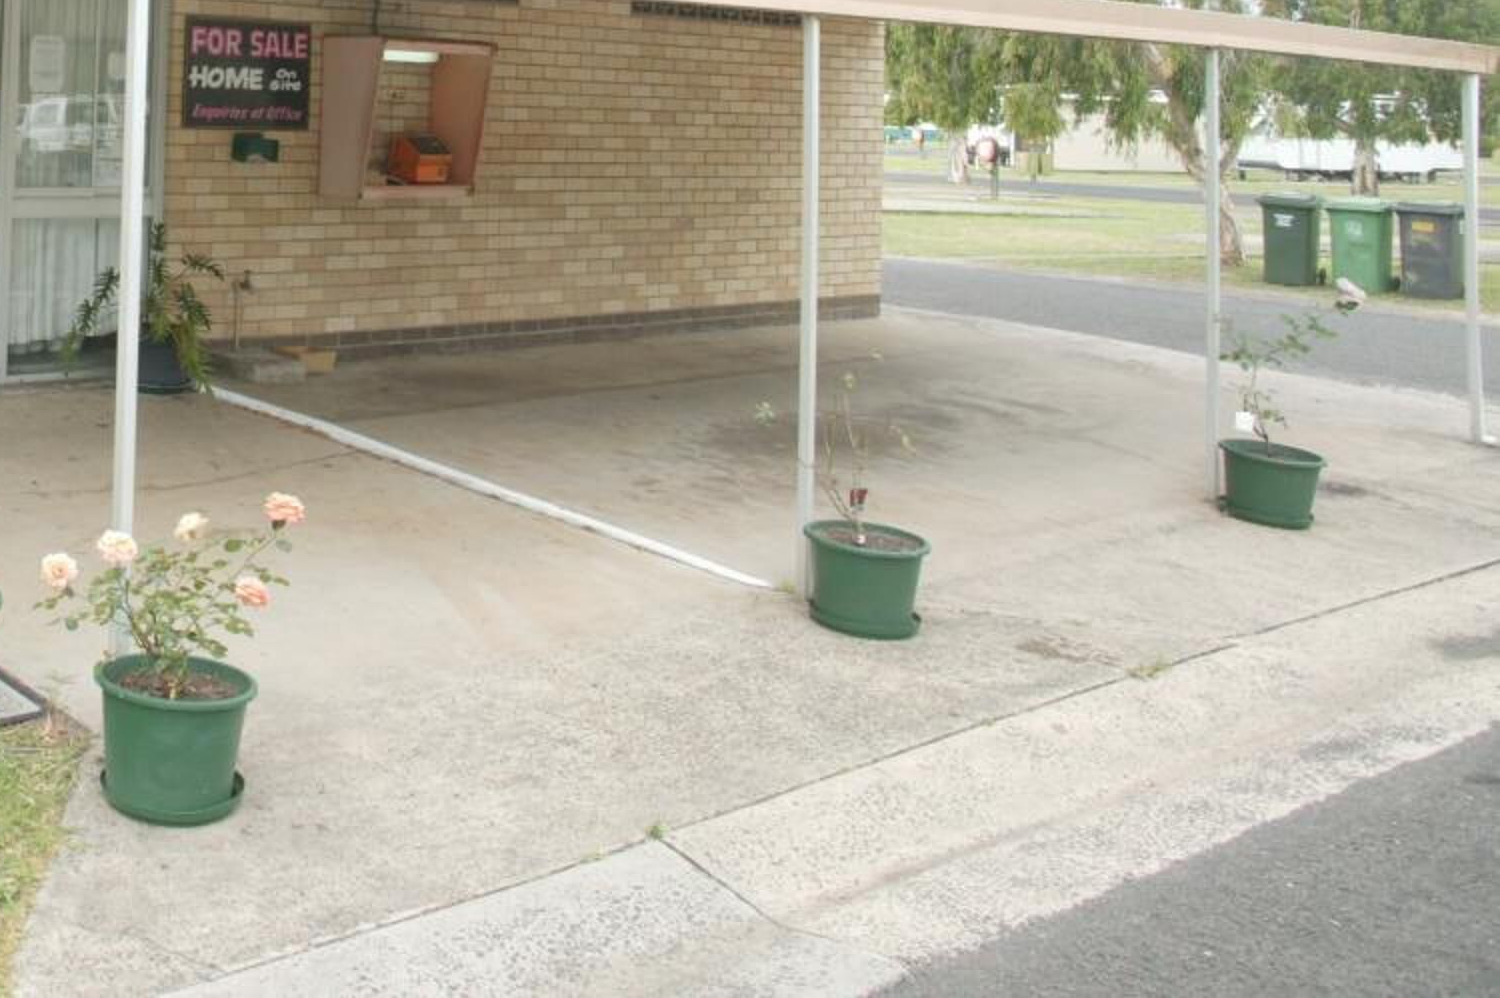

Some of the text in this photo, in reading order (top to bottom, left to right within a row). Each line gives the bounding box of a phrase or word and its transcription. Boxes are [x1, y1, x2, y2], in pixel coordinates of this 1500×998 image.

[191, 27, 308, 58] FOR SALE
[189, 66, 263, 90] HOME
